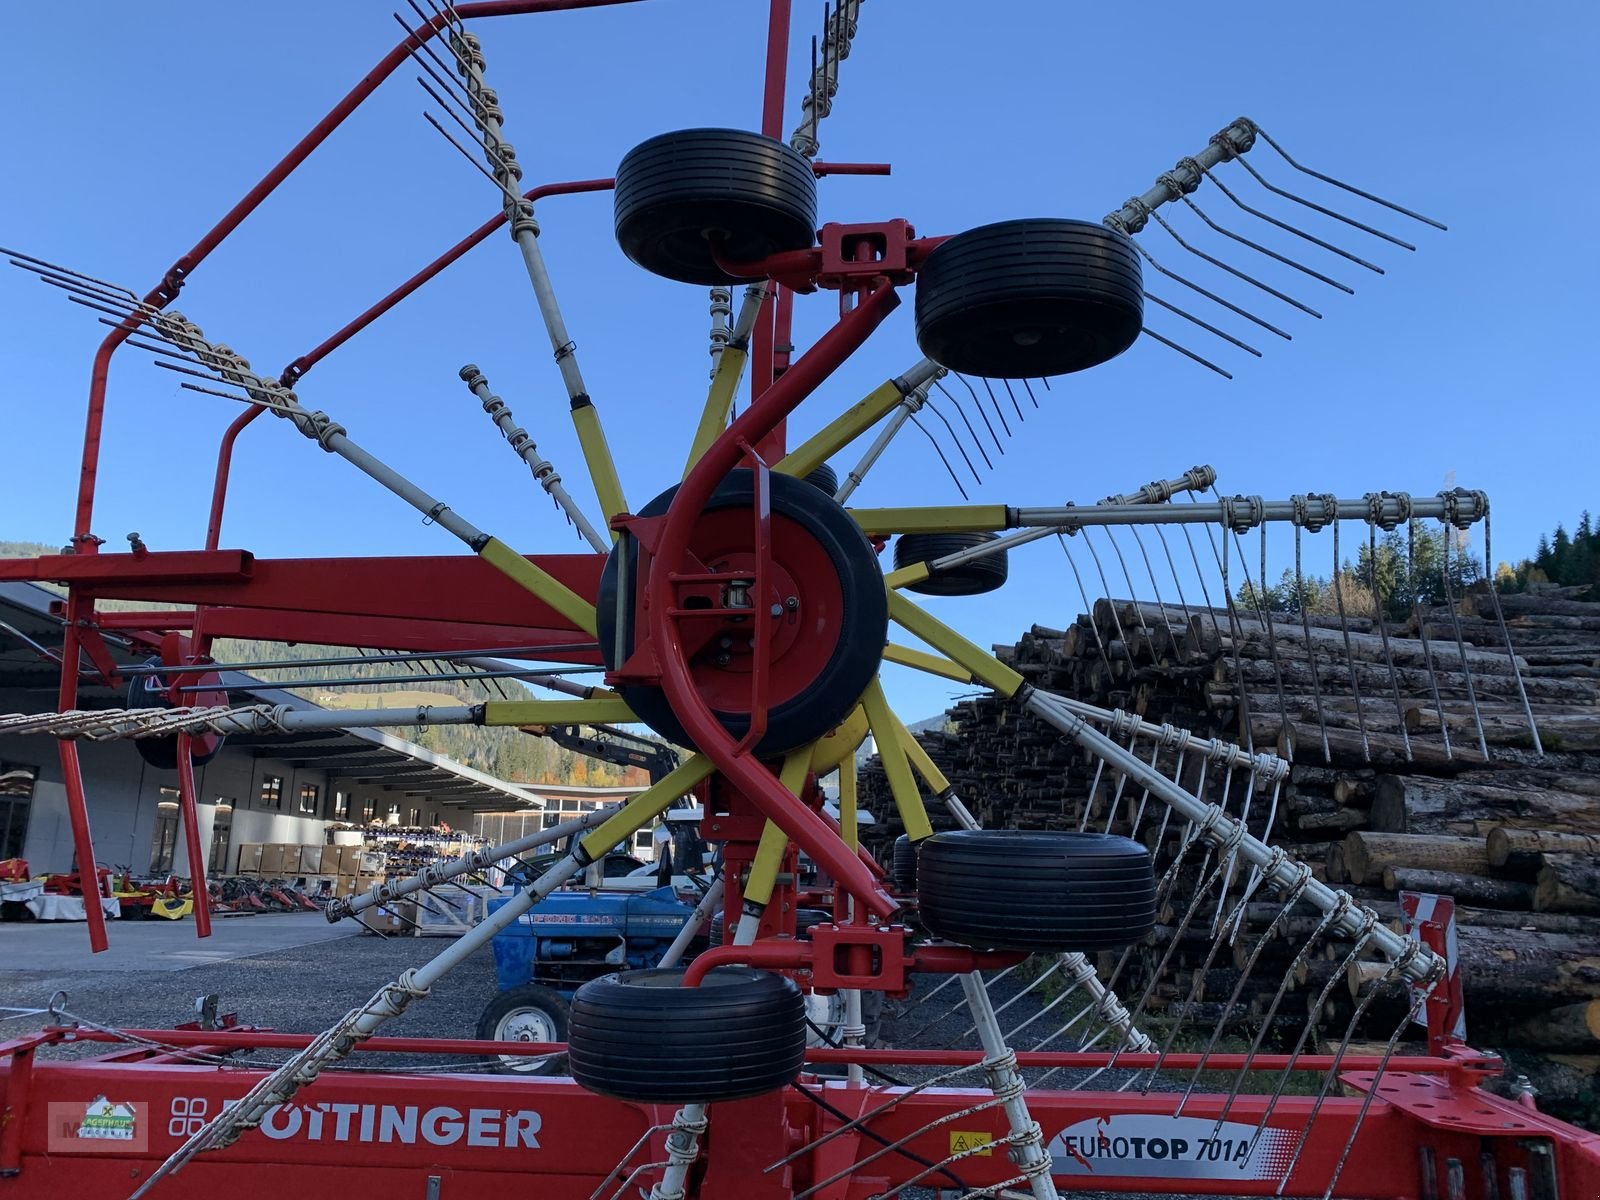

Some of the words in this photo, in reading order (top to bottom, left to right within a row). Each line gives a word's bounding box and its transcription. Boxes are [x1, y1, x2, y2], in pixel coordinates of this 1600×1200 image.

[223, 1099, 542, 1149] ÖTTINGER
[1065, 1136, 1189, 1160] EUROTOP
[1196, 1138, 1251, 1162] 701A
